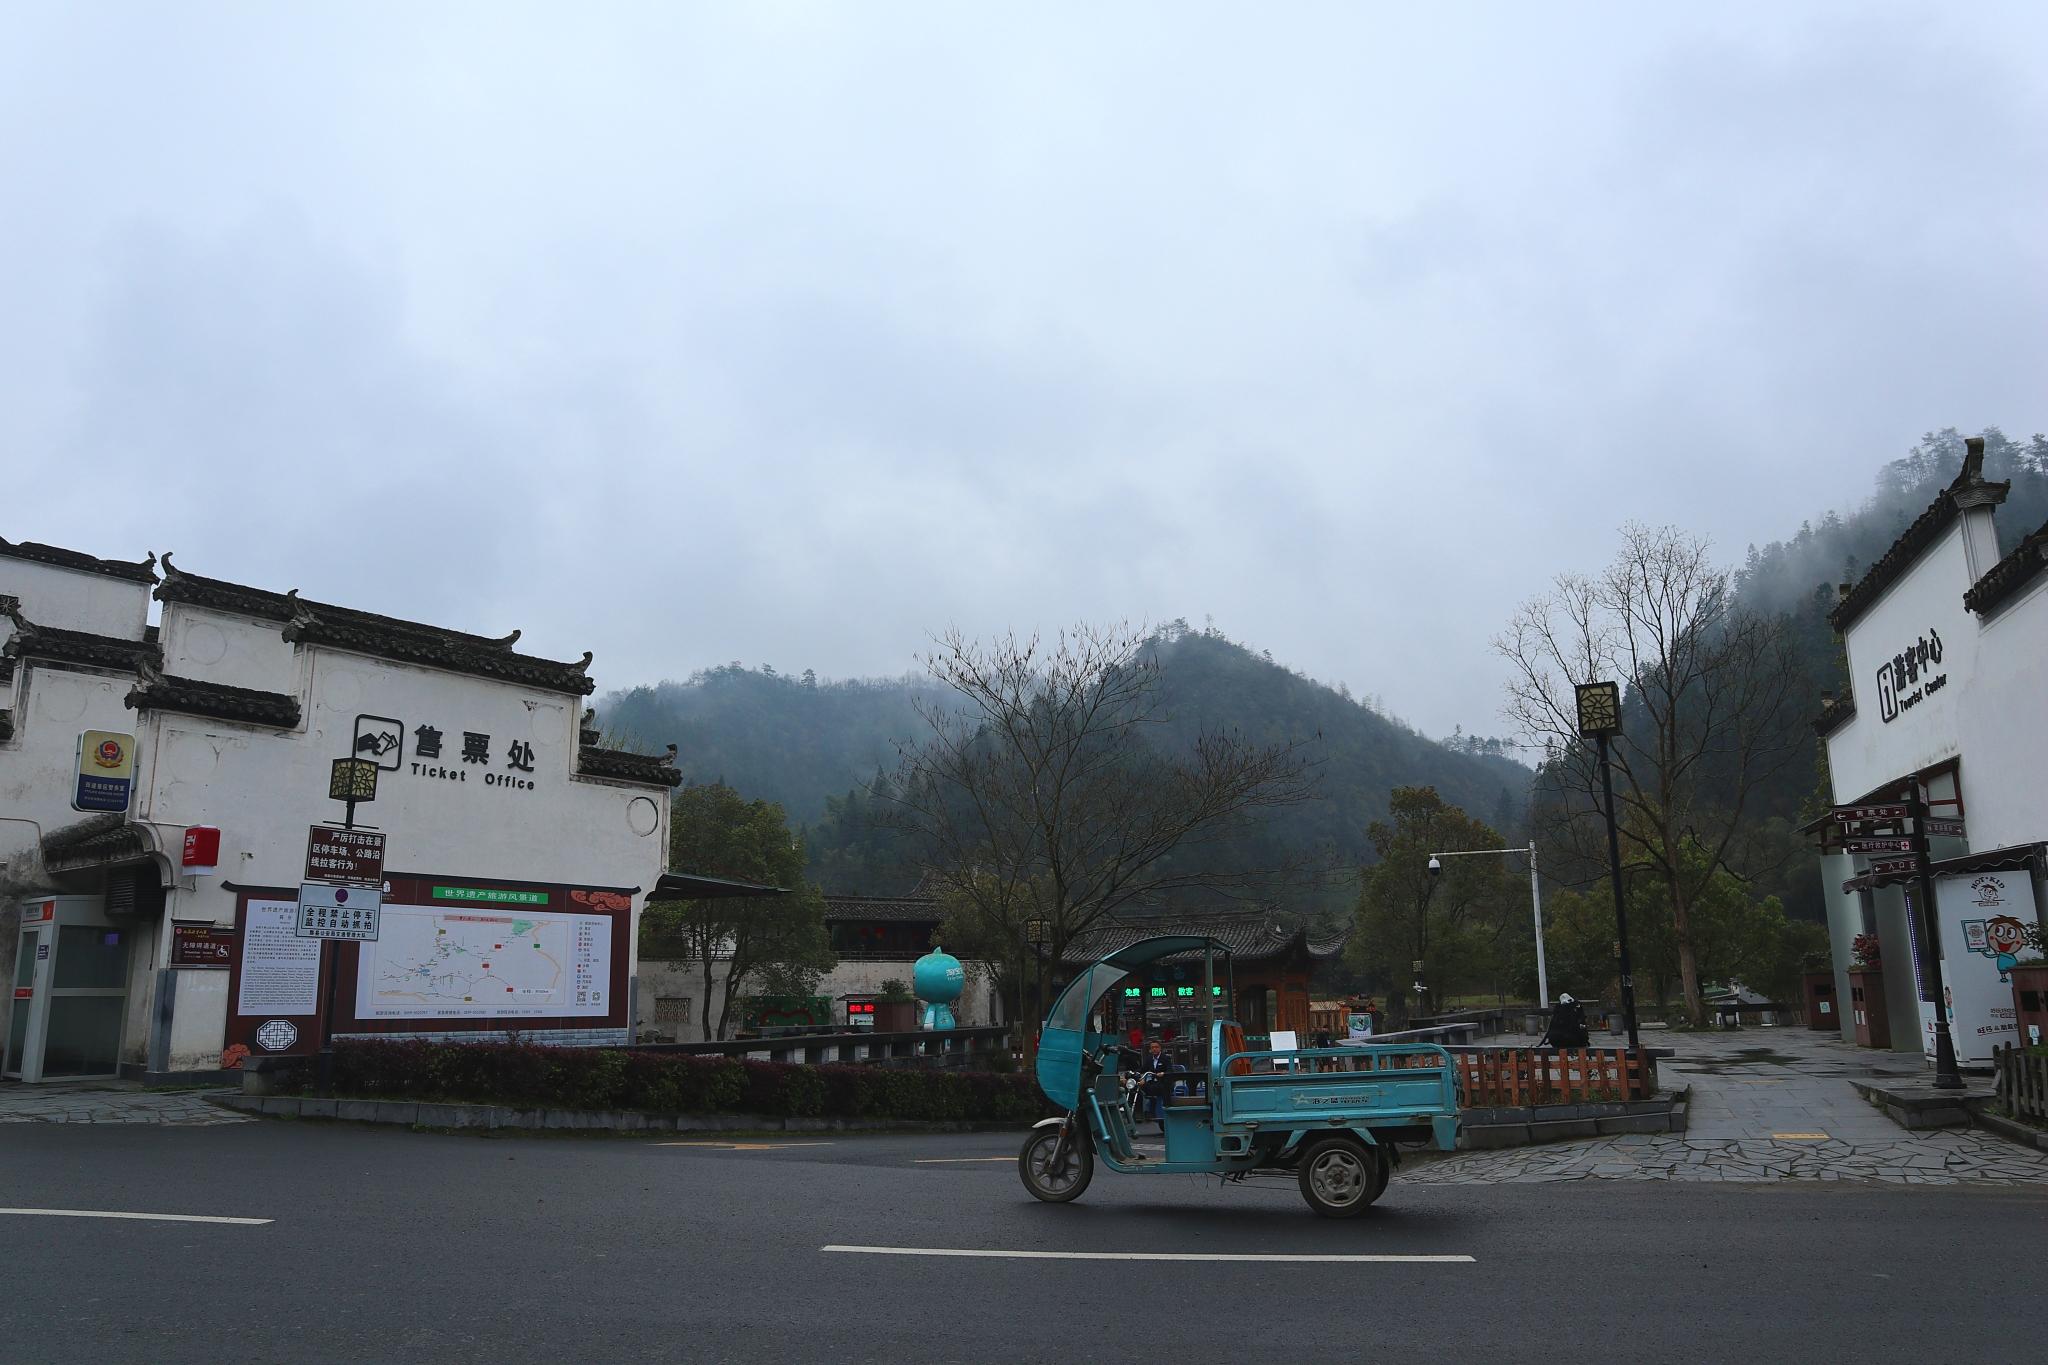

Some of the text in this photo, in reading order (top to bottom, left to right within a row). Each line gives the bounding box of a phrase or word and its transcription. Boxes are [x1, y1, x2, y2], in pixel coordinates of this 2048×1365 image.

[1893, 628, 1942, 692] 游客中心
[1899, 688, 1923, 712] Tourist
[415, 724, 535, 773] 售票处
[411, 763, 535, 790] Ticket Office
[331, 832, 382, 847] 严厉打击在景
[312, 844, 381, 860] 区停车场、公路沿
[445, 889, 538, 903] 世界遗产旅游风景道
[306, 907, 372, 921] 全程禁止停车
[305, 918, 371, 930] 监控自动抓拍
[1125, 987, 1140, 997] 免费
[1151, 987, 1166, 997] 团队
[1178, 987, 1193, 997] 散客
